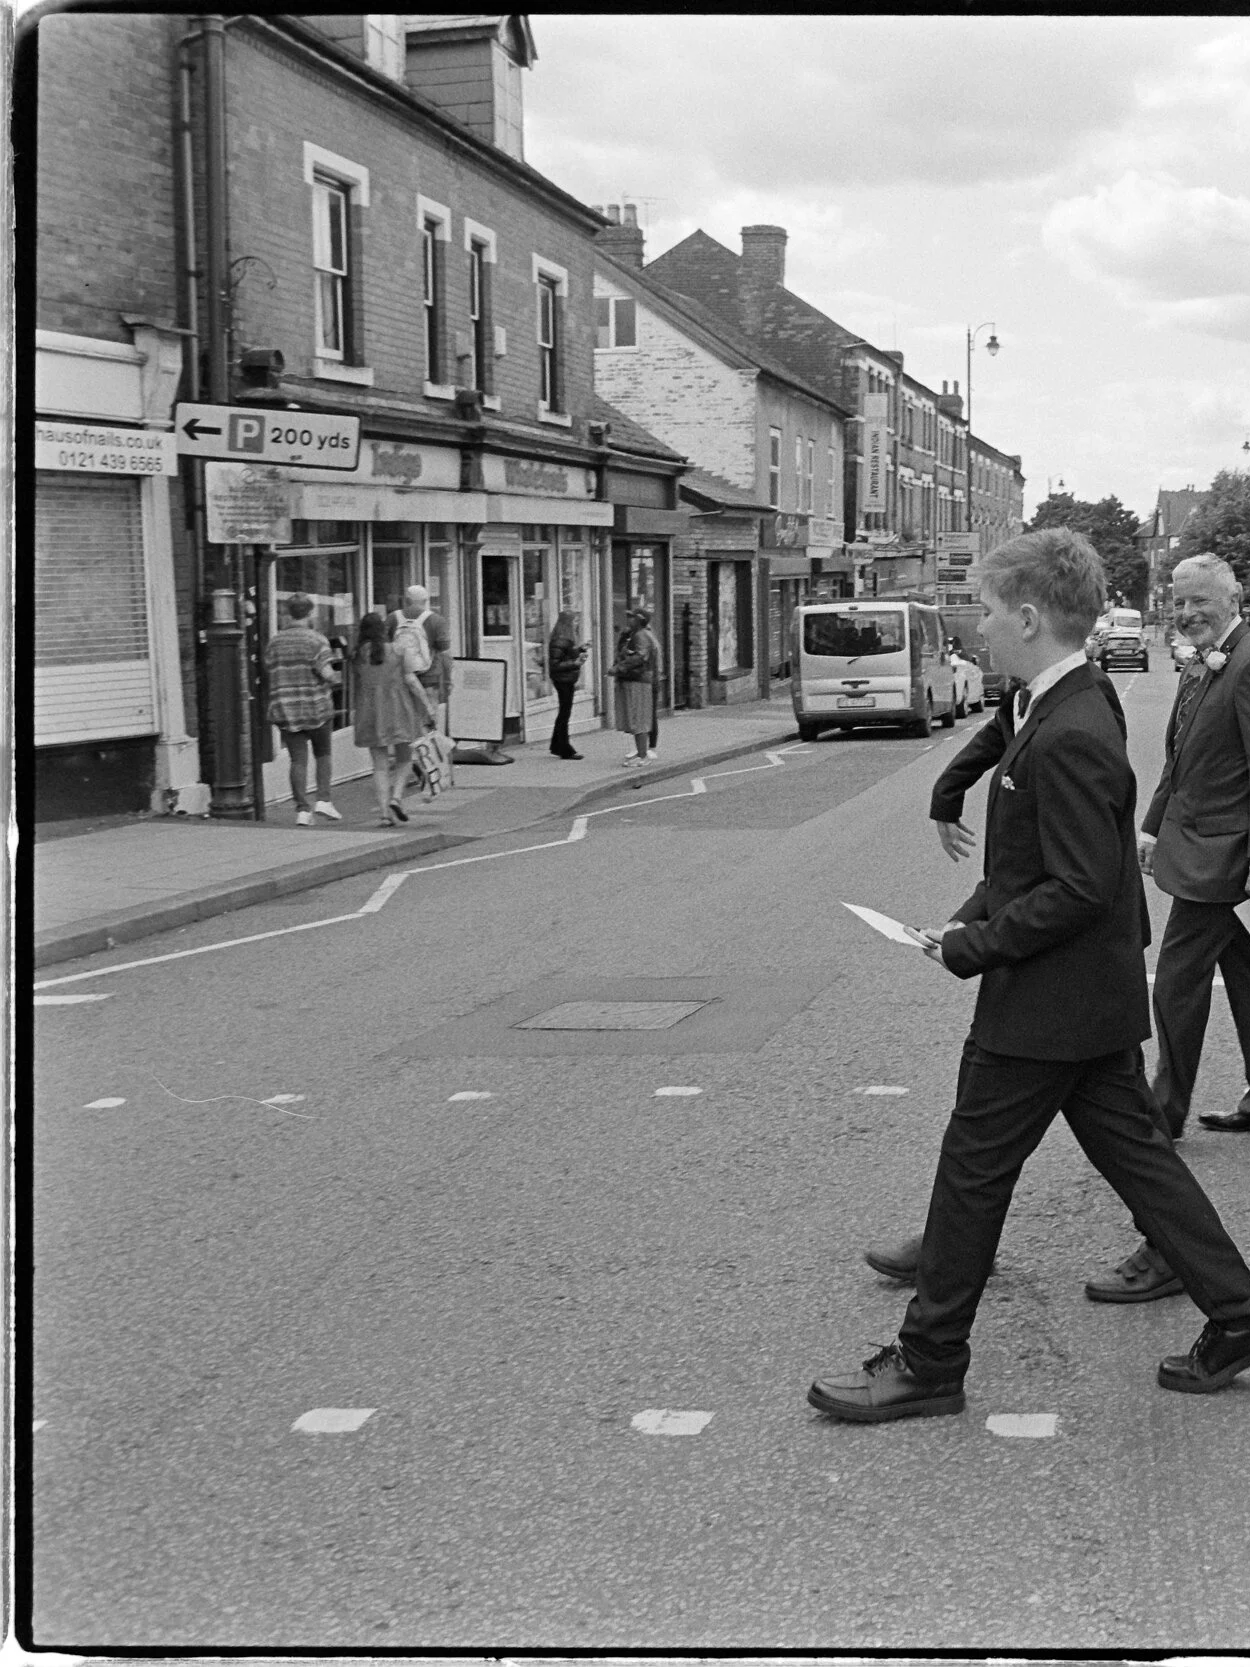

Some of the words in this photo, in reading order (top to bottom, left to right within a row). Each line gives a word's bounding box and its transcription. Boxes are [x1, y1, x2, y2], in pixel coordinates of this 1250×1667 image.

[236, 418, 260, 449] P
[269, 426, 313, 447] 200
[317, 430, 350, 451] yds
[870, 430, 880, 454] INDIAN
[58, 450, 95, 468] 0121
[869, 455, 880, 498] RESTAURANT
